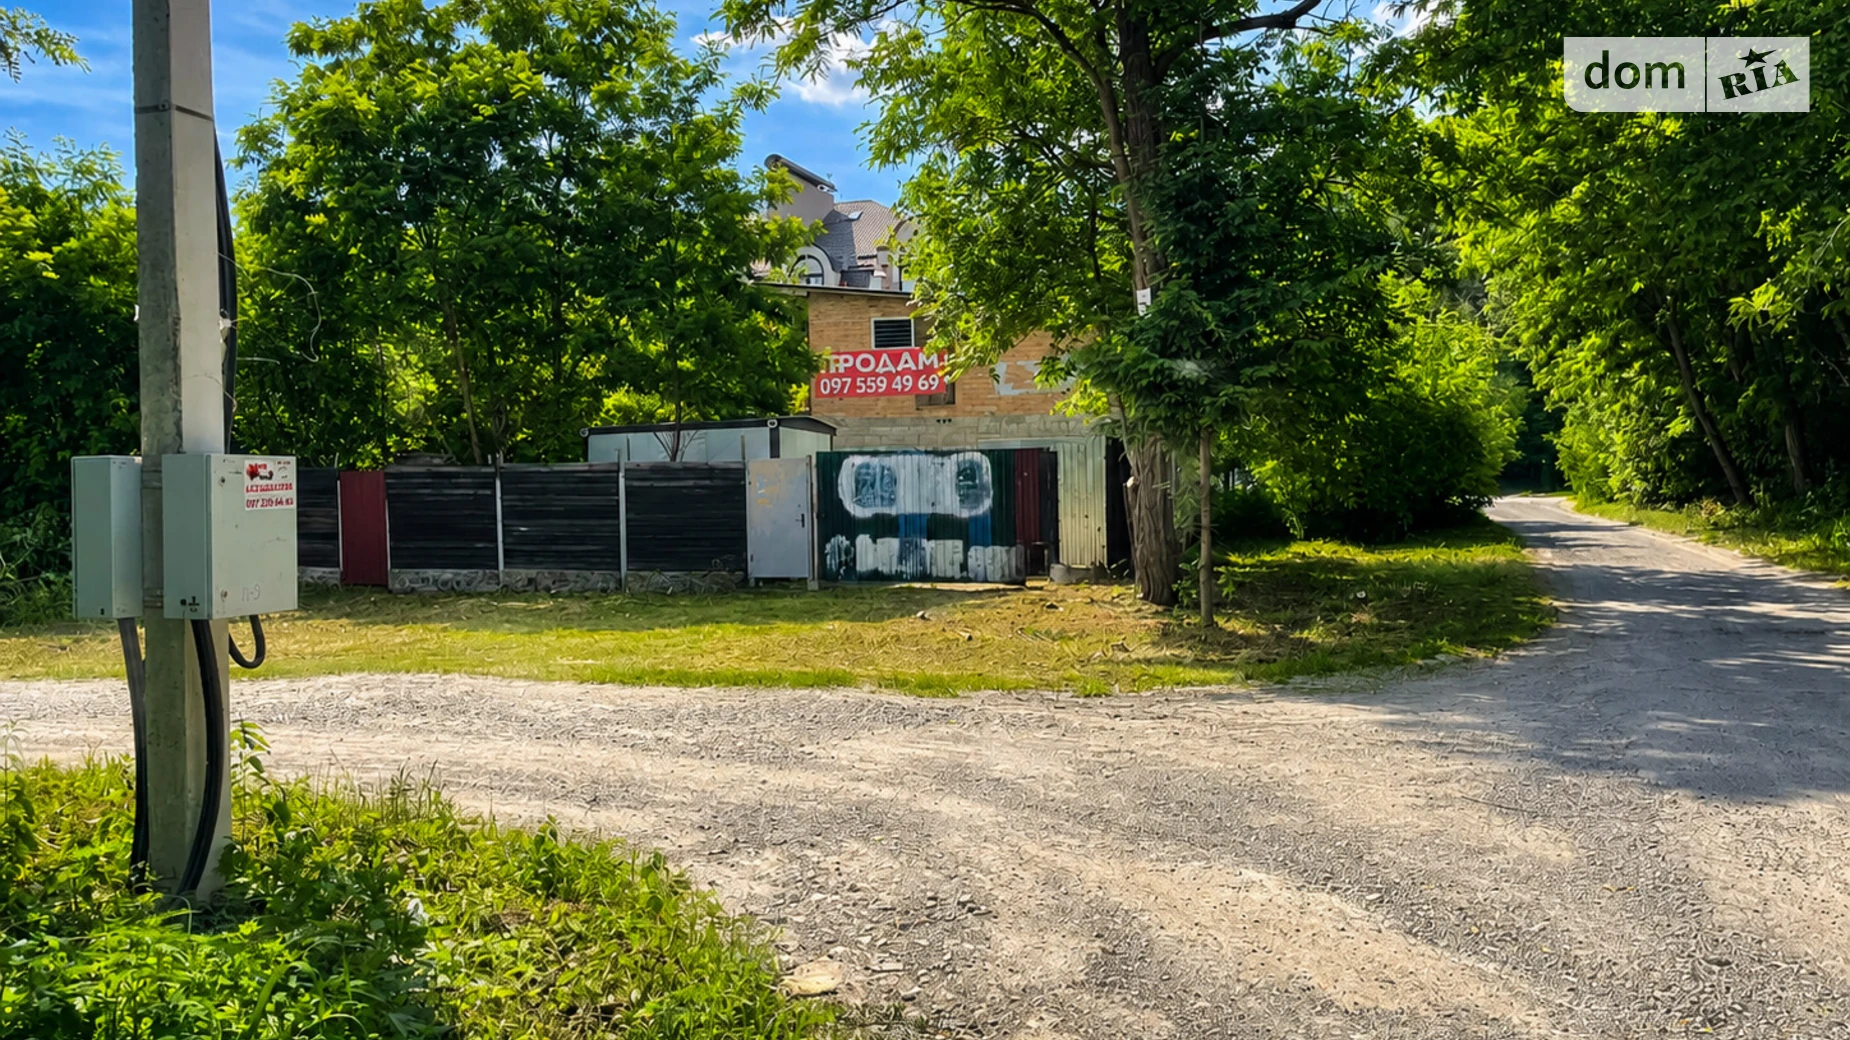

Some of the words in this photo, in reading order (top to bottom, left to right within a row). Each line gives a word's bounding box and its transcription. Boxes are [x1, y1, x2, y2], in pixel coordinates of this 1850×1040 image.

[820, 377, 851, 394] 097
[856, 376, 887, 393] 559
[892, 375, 913, 392] 49
[918, 374, 939, 391] 69
